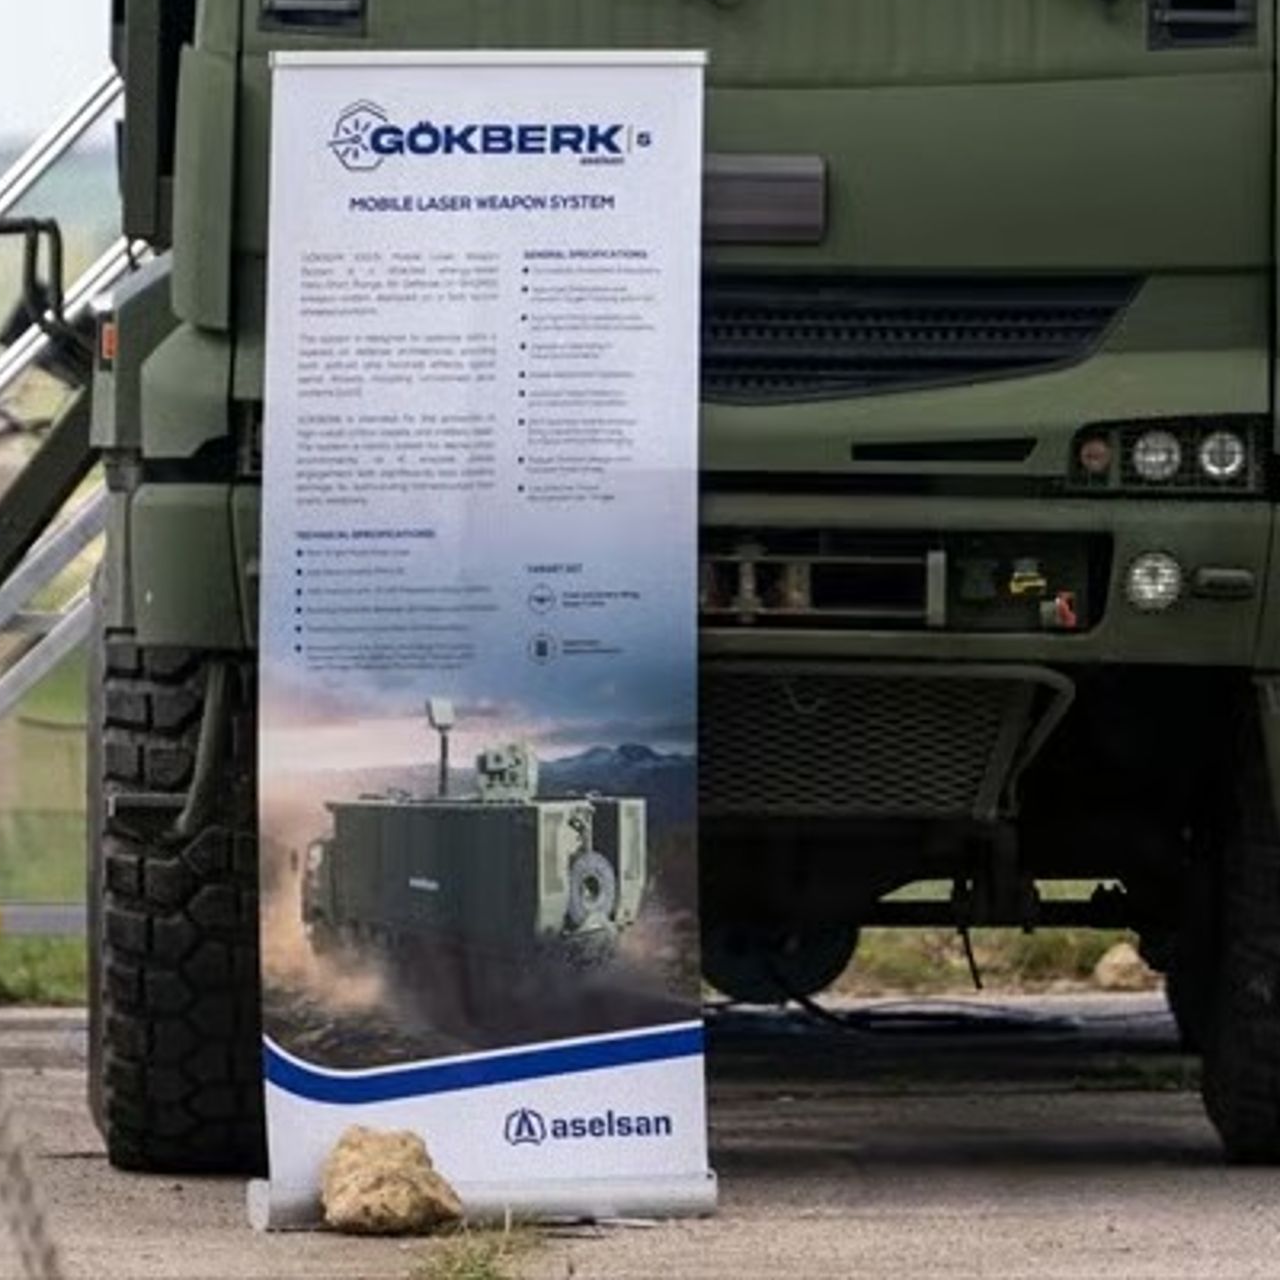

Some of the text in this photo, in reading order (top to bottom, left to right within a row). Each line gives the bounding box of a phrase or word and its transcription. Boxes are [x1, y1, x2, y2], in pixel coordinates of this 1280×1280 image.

[369, 121, 624, 156] GÖKBERK
[349, 194, 615, 212] MOBILE LASER WEAPON SYSTEM
[551, 1109, 672, 1139] aselsan
